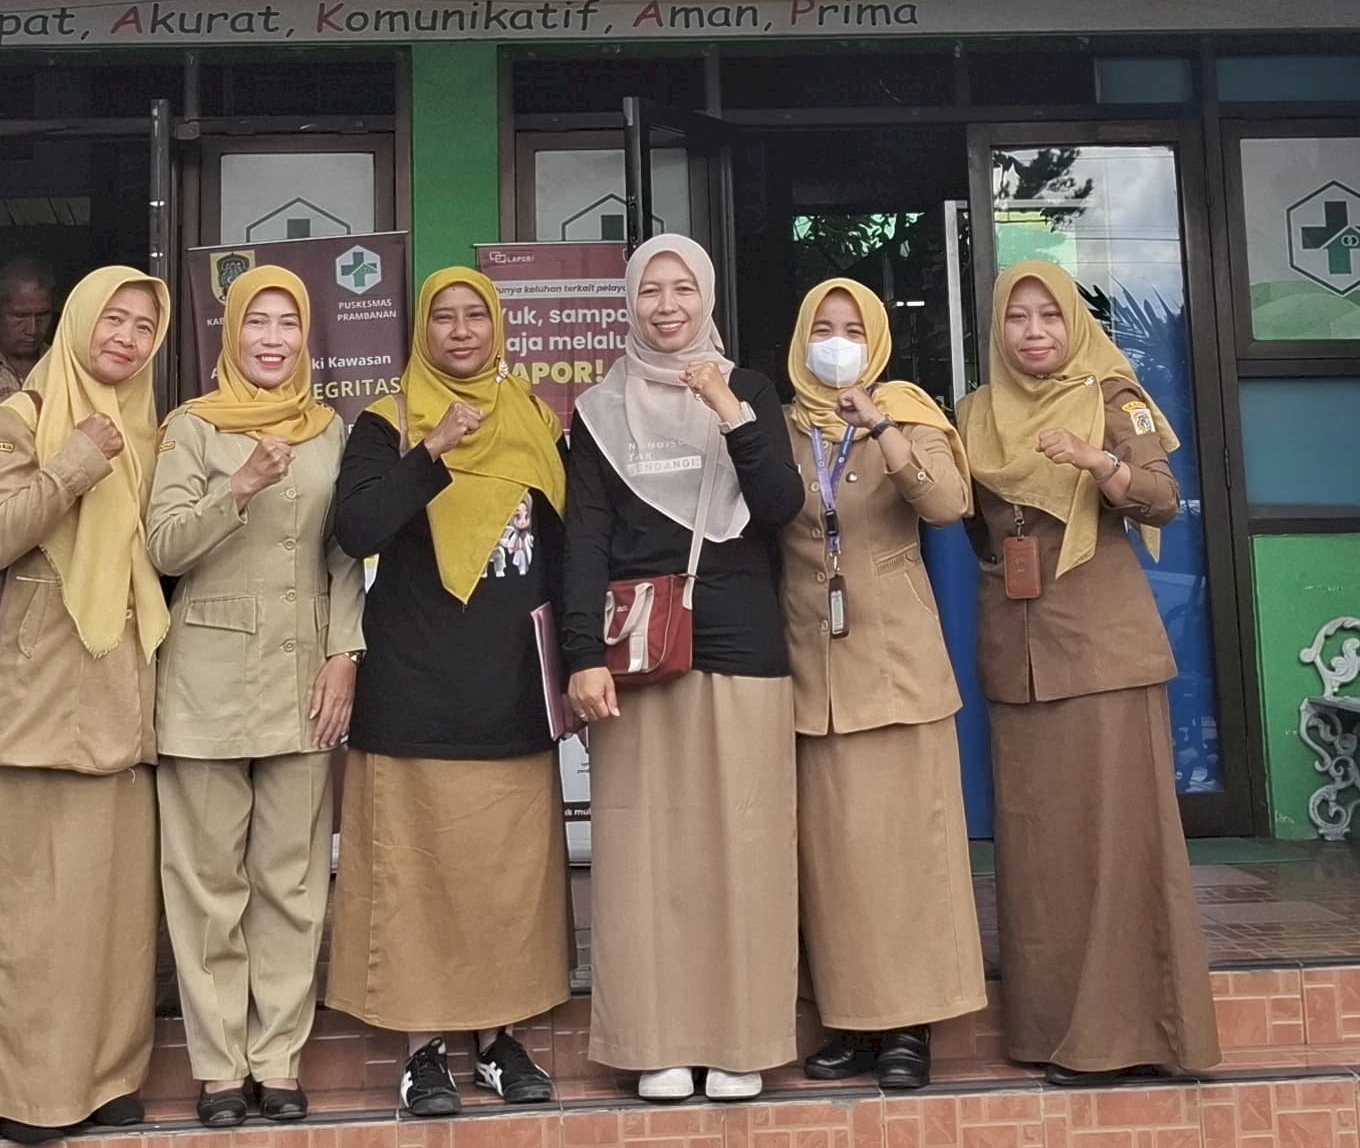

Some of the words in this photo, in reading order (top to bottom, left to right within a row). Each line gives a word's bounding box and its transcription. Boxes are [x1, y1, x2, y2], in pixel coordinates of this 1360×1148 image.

[109, 3, 295, 39] Akurat,
[314, 0, 612, 36] Komunikatif,
[632, 0, 774, 35] Aman,
[524, 285, 562, 293] keluhan
[564, 284, 595, 292] terkait
[339, 298, 392, 310] PUSKESMAS
[337, 310, 397, 322] PRAMBANAN
[329, 355, 391, 369] Kawasan
[313, 377, 401, 400] EGRITAS
